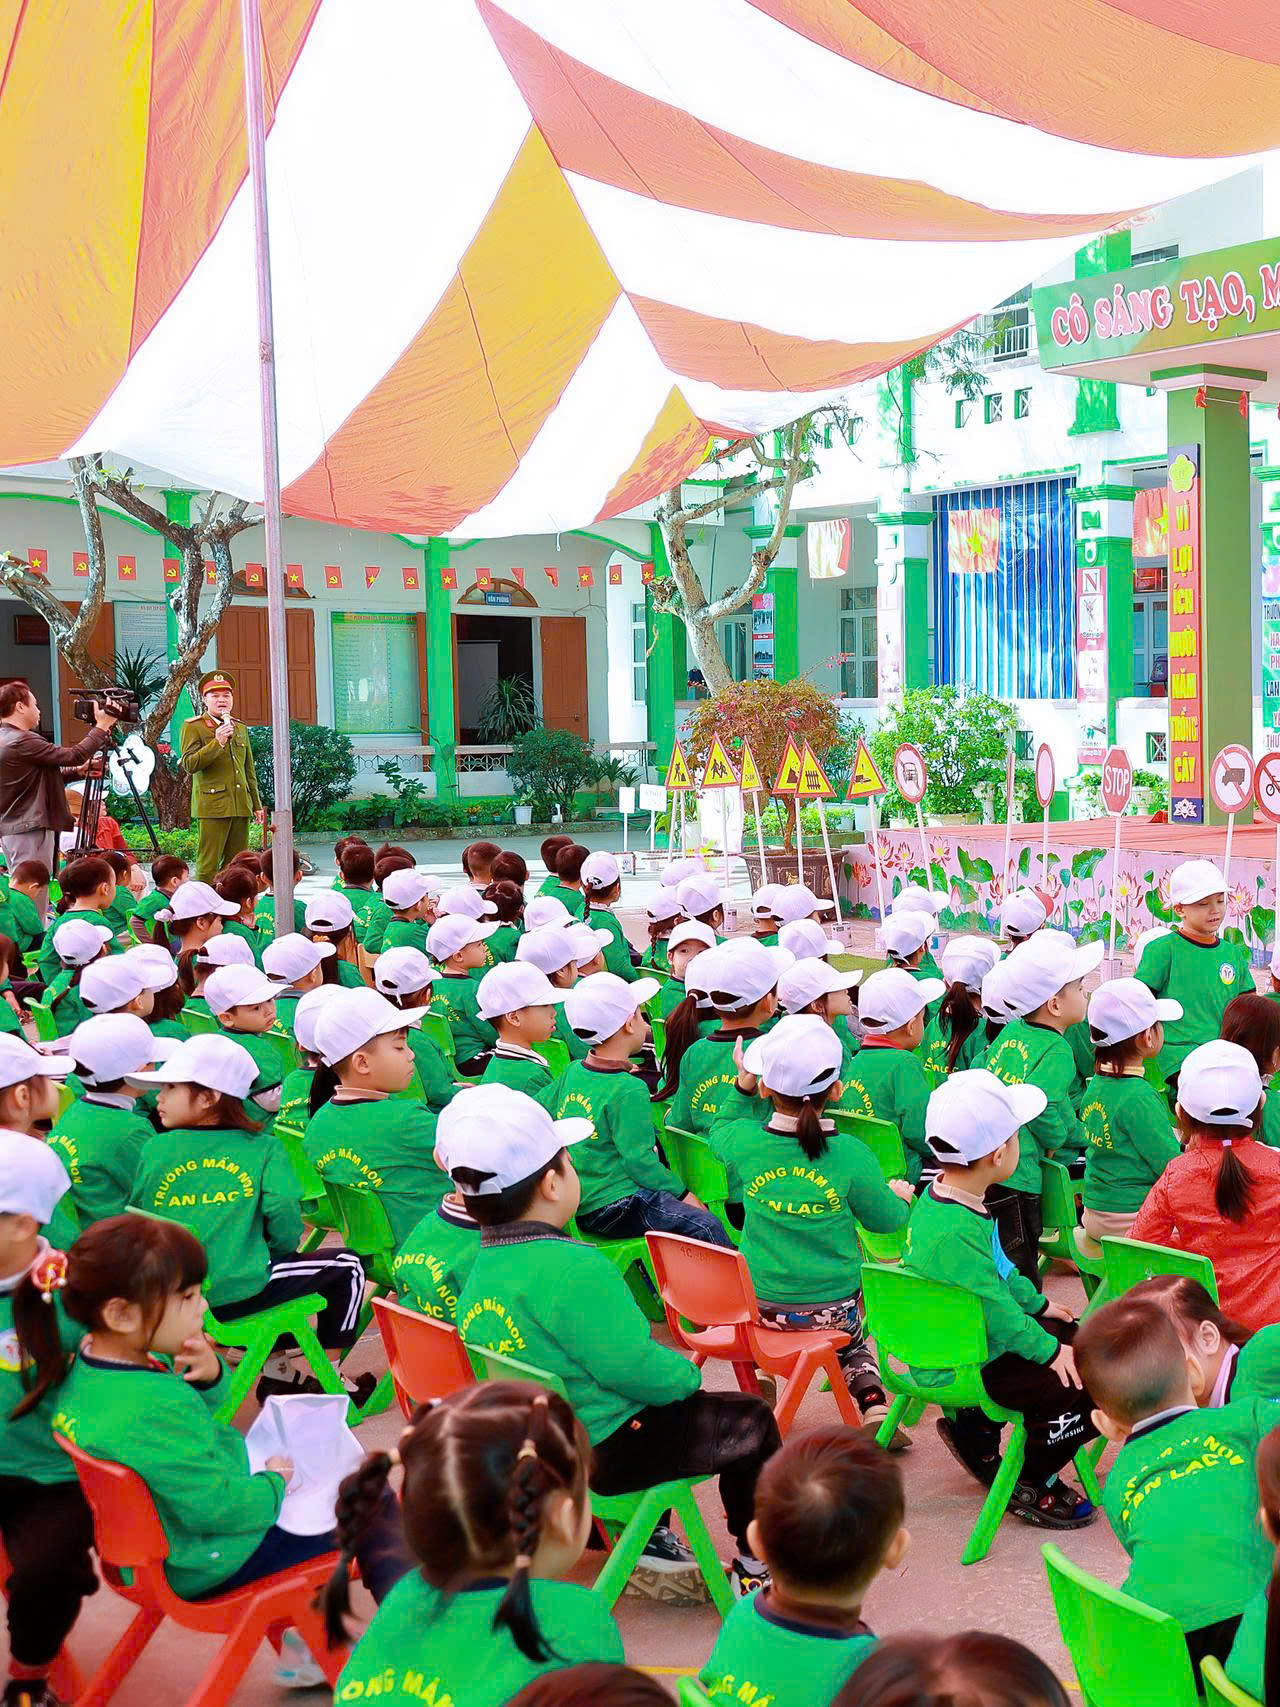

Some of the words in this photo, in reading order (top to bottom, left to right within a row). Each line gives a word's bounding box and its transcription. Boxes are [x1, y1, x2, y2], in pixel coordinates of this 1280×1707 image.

[1051, 294, 1090, 347] CÔ
[1095, 284, 1174, 338] SÁNG
[1180, 271, 1256, 331] TẠO,
[1175, 500, 1190, 531] VÌ
[1172, 546, 1193, 577] LỢI
[1173, 584, 1194, 615] ÍCH
[1266, 681, 1280, 697] LAN
[1104, 765, 1130, 796] STOP
[1174, 751, 1196, 783] CÂY
[702, 1103, 717, 1113] AN
[154, 1160, 198, 1208] TRƯỜNG
[202, 1156, 241, 1175] MẦM
[360, 1164, 384, 1188] NON
[792, 1166, 828, 1188] MẦM
[824, 1188, 842, 1212] NON
[168, 1194, 196, 1207] AN
[201, 1191, 240, 1207] LẠC
[787, 1203, 825, 1217] LẠC
[504, 1314, 528, 1351] NON
[1170, 1454, 1219, 1480] LẠC
